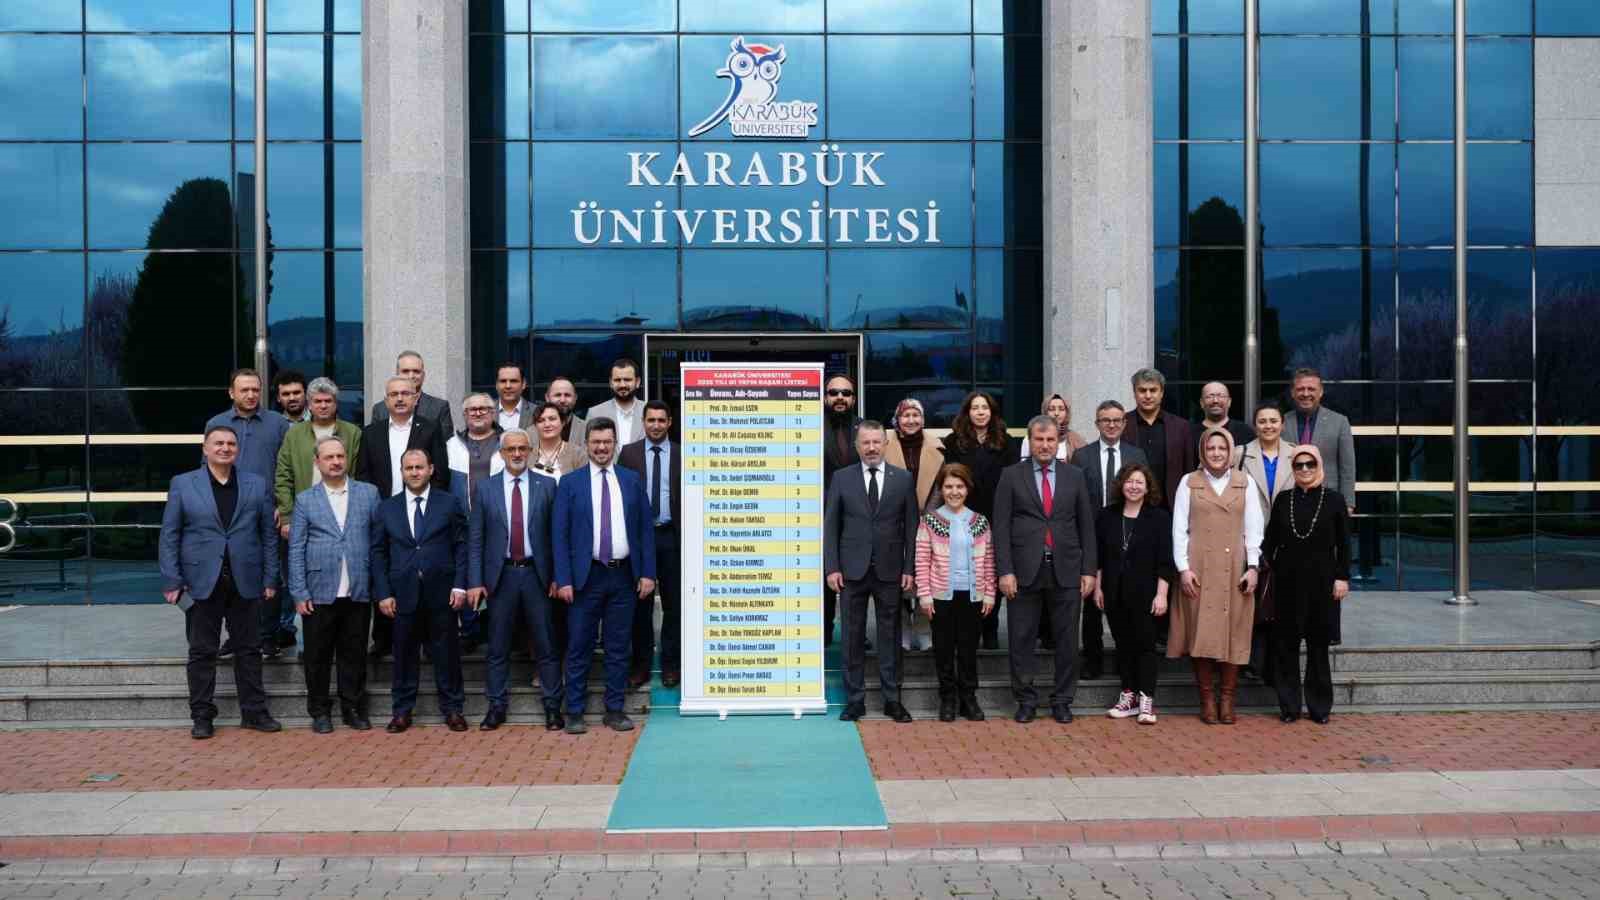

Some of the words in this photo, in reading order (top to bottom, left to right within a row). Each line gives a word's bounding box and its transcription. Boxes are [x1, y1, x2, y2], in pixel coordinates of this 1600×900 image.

[732, 102, 816, 120] KARABÜK
[627, 144, 885, 186] KARABÜK
[570, 200, 941, 244] ÜNİVERSİTESİ
[710, 404, 721, 412] Prof.
[710, 431, 720, 439] Prof.
[710, 488, 720, 496] Prof.
[710, 502, 720, 510] Prof.
[710, 544, 721, 552] Prof.
